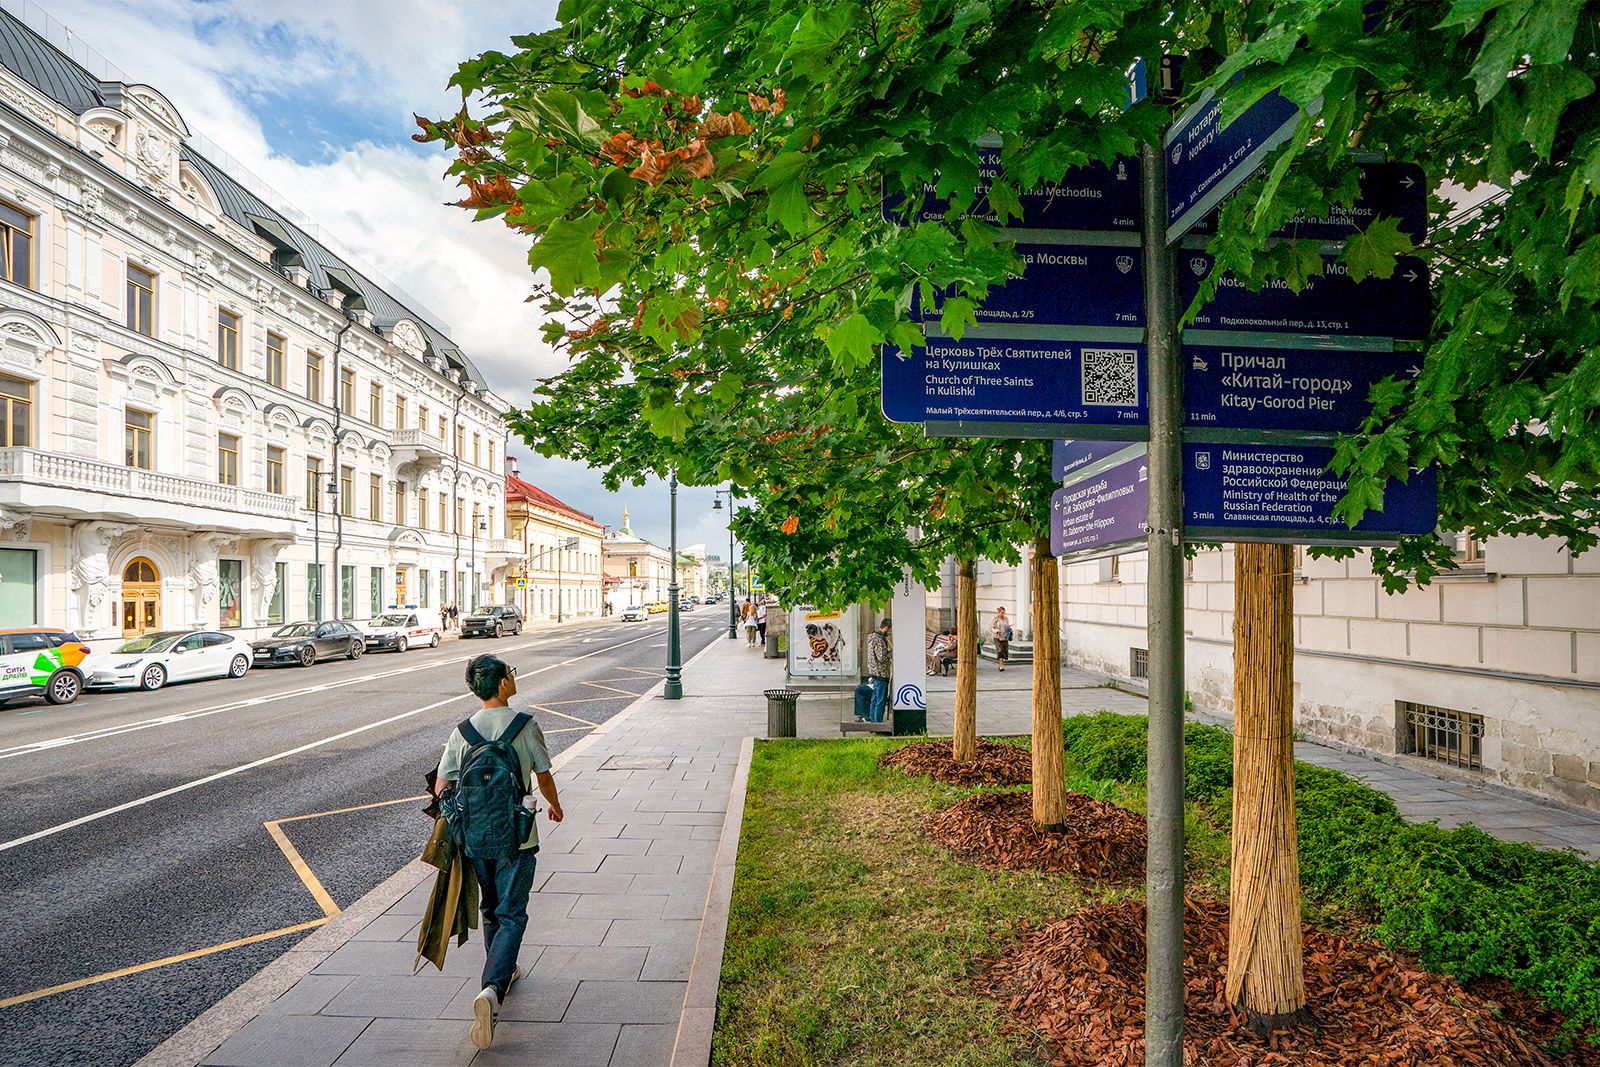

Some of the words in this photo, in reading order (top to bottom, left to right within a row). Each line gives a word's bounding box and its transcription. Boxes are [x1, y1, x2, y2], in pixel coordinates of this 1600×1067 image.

[1188, 129, 1214, 161] Notary
[1246, 138, 1252, 149] 2
[1046, 186, 1103, 198] Methodius
[1171, 210, 1175, 218] 2
[1175, 202, 1185, 215] min
[1113, 218, 1119, 226] 4
[1120, 217, 1135, 226] min
[1037, 253, 1088, 266] Москвы
[1012, 311, 1020, 320] д.
[1021, 310, 1035, 319] 2/5
[1116, 313, 1121, 321] 7
[1122, 313, 1137, 321] min
[1196, 315, 1210, 324] min
[1220, 316, 1287, 328] Подколокольный
[1316, 320, 1327, 329] 13,
[1328, 321, 1343, 330] стр.
[1345, 321, 1349, 329] 1
[925, 346, 975, 360] Церковь
[976, 346, 1003, 359] Трёх
[1005, 347, 1072, 360] Святителей
[925, 361, 940, 370] на
[942, 359, 1001, 373] Кулишках
[1221, 352, 1286, 371] Причал
[925, 374, 961, 385] Church
[962, 375, 973, 386] of
[974, 376, 1002, 386] Three
[1003, 376, 1034, 387] Saints
[1221, 373, 1352, 394] «Китай-город»
[925, 385, 936, 395] in
[937, 386, 976, 397] Kulishki
[1221, 394, 1305, 411] Kitay-Gorod
[1309, 397, 1336, 410] Pier
[926, 406, 953, 416] Малый
[954, 407, 1026, 418] Трёхсвятительский
[1045, 411, 1052, 419] д.
[1053, 409, 1067, 419] 4/6,
[1067, 411, 1082, 419] стр.
[1083, 410, 1088, 418] 5
[1117, 410, 1122, 419] 7
[1123, 410, 1139, 419] min
[1190, 412, 1200, 421] 11
[1201, 412, 1216, 421] min
[1222, 451, 1304, 464] Министерство
[1222, 465, 1323, 477] здравоохранения
[1087, 480, 1108, 497] усадьба
[1222, 476, 1288, 489] Российской
[1290, 478, 1347, 491] Федераци
[1223, 490, 1263, 504] Ministry
[1264, 491, 1275, 502] of
[1276, 491, 1308, 502] Health
[1309, 492, 1320, 502] of
[1320, 492, 1337, 503] the
[1223, 502, 1260, 512] Russian
[1261, 502, 1312, 513] Federation
[1063, 516, 1076, 527] Urban
[1075, 513, 1089, 524] estate
[1089, 509, 1095, 519] of
[1193, 511, 1198, 520] 5
[1199, 511, 1214, 520] min
[1223, 512, 1269, 522] Славянская
[1270, 515, 1308, 525] площадь,
[1309, 516, 1316, 525] д.
[1317, 515, 1324, 525] 4,
[1094, 516, 1115, 530] Filippovs
[2, 672, 27, 680] ДРАЙВ
[6, 666, 26, 674] СИТИ
